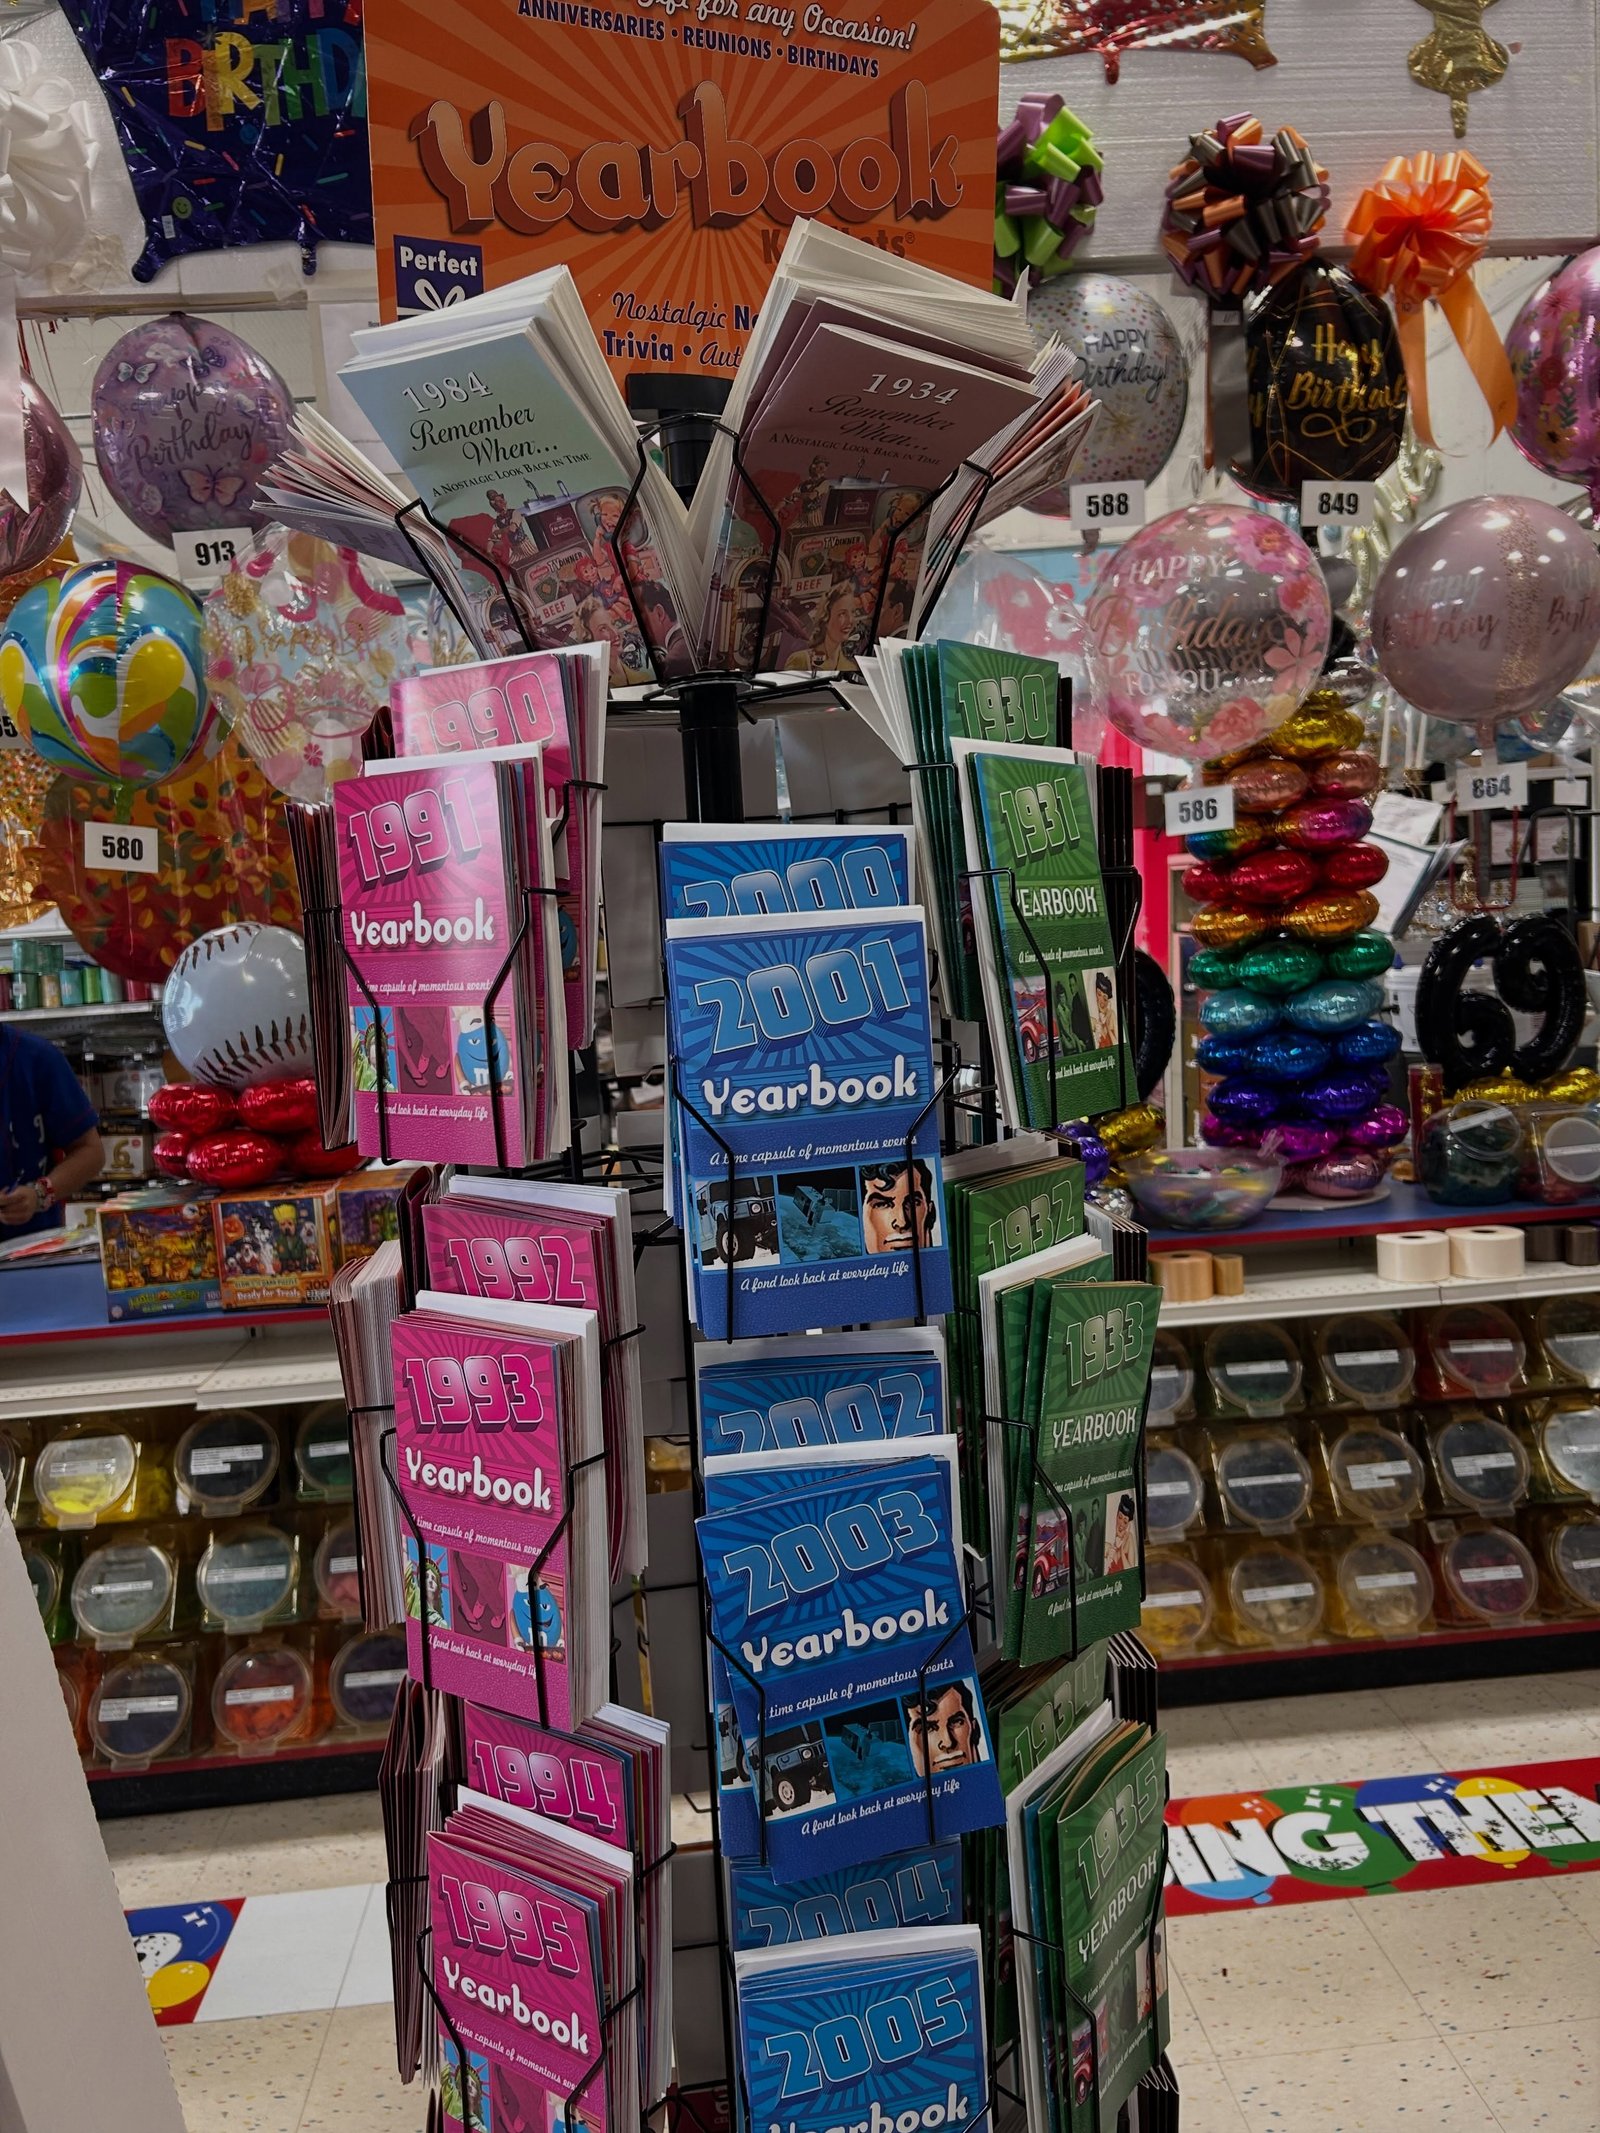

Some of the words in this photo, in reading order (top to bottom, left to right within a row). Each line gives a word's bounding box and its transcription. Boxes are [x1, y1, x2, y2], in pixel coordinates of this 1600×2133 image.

[517, 0, 665, 41] ANNIVERSARIES
[682, 27, 772, 60] REUNIONS
[787, 46, 880, 79] BIRTHDAYS
[696, 0, 738, 21] for
[745, 4, 795, 36] any
[803, 4, 917, 50] Occasion!
[410, 79, 965, 232] Yearbook
[400, 245, 478, 277] Perfect
[612, 292, 727, 334] Nostalgic
[602, 330, 675, 362] Trivia
[699, 341, 742, 369] Aut
[1083, 328, 1149, 354] HAPPY
[402, 371, 492, 413] 1984
[809, 394, 955, 430] Remember
[863, 373, 959, 405] 1934
[410, 404, 535, 451] Remember
[769, 433, 778, 443] A
[782, 433, 839, 450] NOSTALGIC
[432, 486, 441, 497] A
[441, 472, 494, 493] NOSTALGIC
[495, 466, 523, 480] LOOK
[524, 460, 550, 474] BACK
[565, 452, 592, 465] TIME
[1086, 492, 1130, 518] 588
[1318, 492, 1359, 516] 849
[195, 541, 236, 566] 913
[1129, 554, 1226, 584] HAPPY
[542, 601, 567, 619] BEEF
[796, 578, 822, 592] BEEF
[0, 716, 18, 737] 5
[409, 671, 555, 756] 1990
[958, 674, 1048, 743] 1930
[1178, 800, 1218, 822] 586
[1472, 776, 1511, 799] 864
[349, 778, 482, 887] 1991
[1000, 777, 1080, 860] 1931
[102, 836, 144, 861] 580
[683, 846, 900, 917] 2000
[1016, 886, 1097, 916] EARBOOK
[350, 897, 495, 946] Yearbook
[408, 979, 417, 996] of
[418, 980, 464, 992] momentous
[694, 939, 911, 1054] 2001
[398, 1103, 411, 1115] look
[413, 1103, 429, 1116] back
[429, 1106, 438, 1116] at
[702, 1054, 917, 1115] Yearbook
[710, 1153, 720, 1165] A
[722, 1150, 748, 1164] tme
[751, 1147, 796, 1164] capsule
[798, 1143, 812, 1160] of
[814, 1139, 879, 1156] momentous
[989, 1180, 1075, 1268] 1932
[449, 1235, 586, 1301] 1992
[740, 1278, 750, 1291] A
[751, 1276, 777, 1293] fond
[779, 1272, 800, 1286] look
[802, 1269, 826, 1284] back
[828, 1268, 840, 1282] at
[842, 1264, 889, 1282] everyday
[891, 1261, 909, 1275] life
[1066, 1301, 1144, 1387] 1933
[404, 1354, 544, 1432] 1993
[718, 1373, 935, 1453] 2002
[1053, 1407, 1137, 1449] YEARBOOK
[405, 1447, 552, 1510] Yearbook
[416, 1516, 432, 1531] time
[433, 1522, 463, 1539] capsule
[464, 1529, 474, 1548] of
[475, 1533, 521, 1551] momentous
[523, 1545, 548, 1557] even
[723, 1490, 938, 1616] 2003
[740, 1589, 949, 1672] Yearbook
[432, 1637, 450, 1651] fond
[451, 1642, 465, 1655] look
[466, 1647, 482, 1660] back
[483, 1652, 492, 1663] at
[493, 1657, 527, 1676] everyday
[528, 1663, 537, 1680] lif
[768, 1704, 794, 1719] time
[796, 1690, 838, 1710] capsule
[841, 1683, 854, 1700] of
[856, 1669, 917, 1693] momentous
[1014, 1649, 1099, 1780] 1934
[475, 1740, 617, 1829] 1994
[801, 1822, 811, 1835] A
[812, 1818, 836, 1836] fond
[837, 1811, 858, 1823] look
[860, 1804, 881, 1818] back
[883, 1798, 895, 1809] at
[943, 1779, 960, 1794] life
[1078, 1757, 1159, 1899] 1935
[1164, 1811, 1370, 1886] ING
[441, 1875, 580, 1974] 1995
[749, 1860, 950, 1947] 2004
[1078, 1849, 1157, 1963] YEARBOOK
[442, 1955, 589, 2055] Yearbook
[456, 2021, 473, 2039] time
[475, 2034, 504, 2055] capsule
[505, 2048, 515, 2062] of
[516, 2055, 561, 2083] momentous
[563, 2078, 589, 2098] eves
[765, 1977, 967, 2099] 2005
[769, 2083, 968, 2133] book
